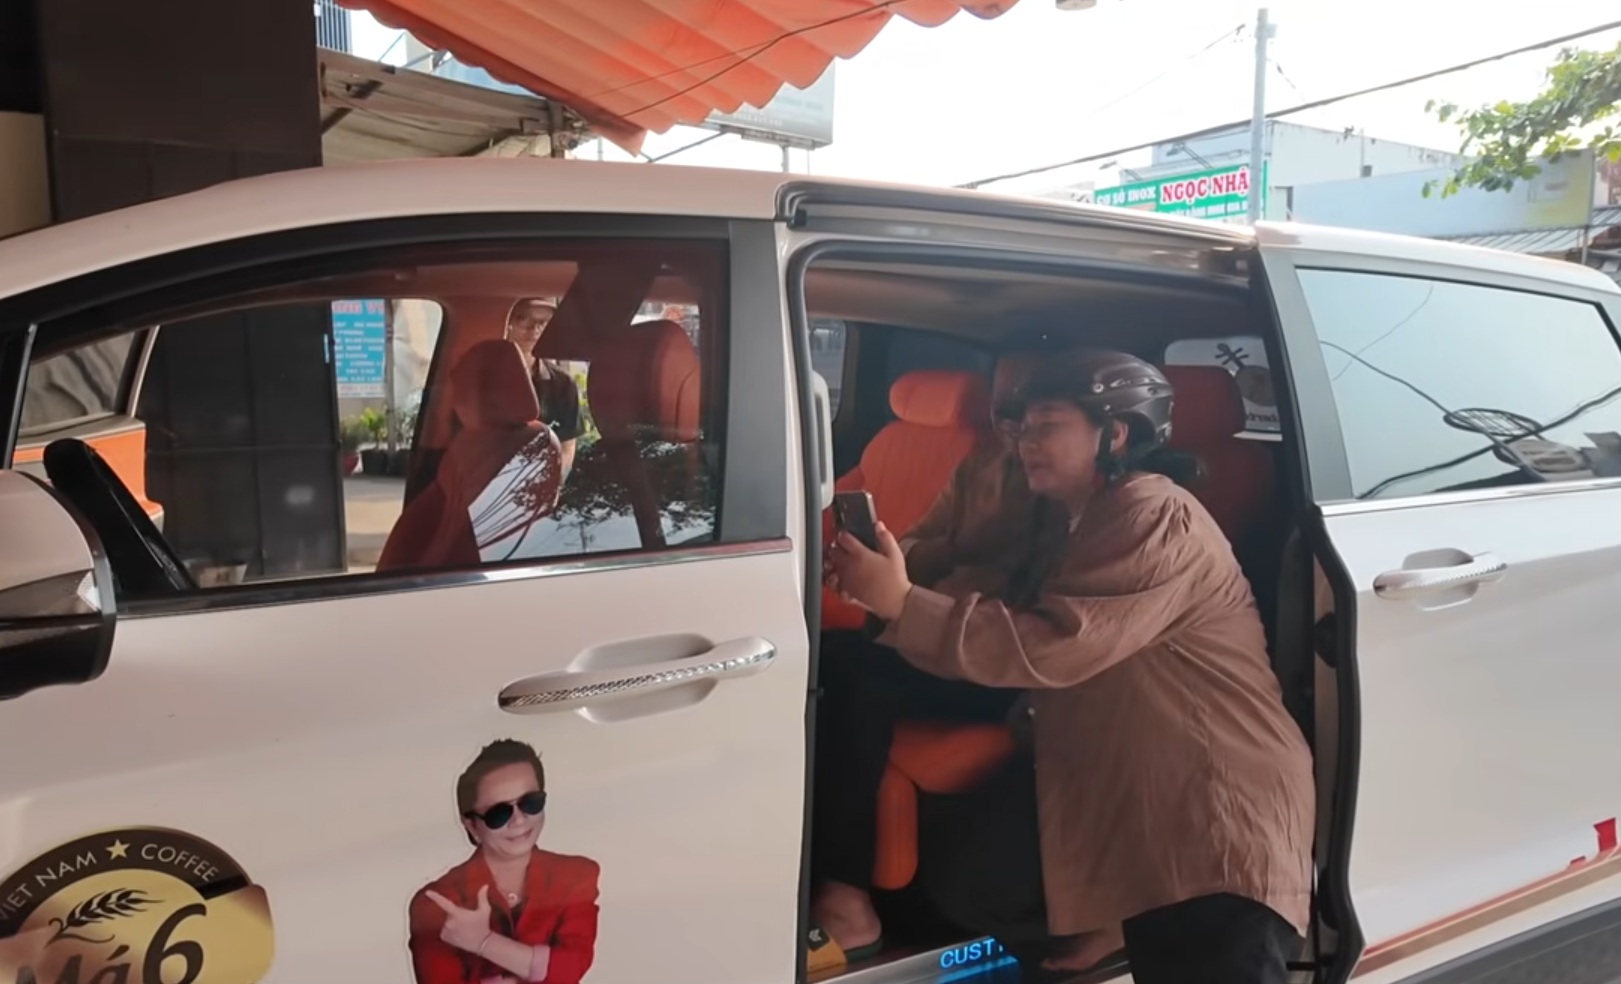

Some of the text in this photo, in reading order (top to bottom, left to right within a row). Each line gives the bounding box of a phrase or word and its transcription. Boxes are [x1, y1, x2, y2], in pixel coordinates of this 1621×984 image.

[1128, 186, 1156, 202] INOX
[1162, 167, 1250, 203] NGỌC NHẬ
[35, 851, 97, 887] NAM
[141, 843, 219, 882] COFFEE
[143, 902, 207, 984] 6
[940, 938, 1003, 968] CUST
